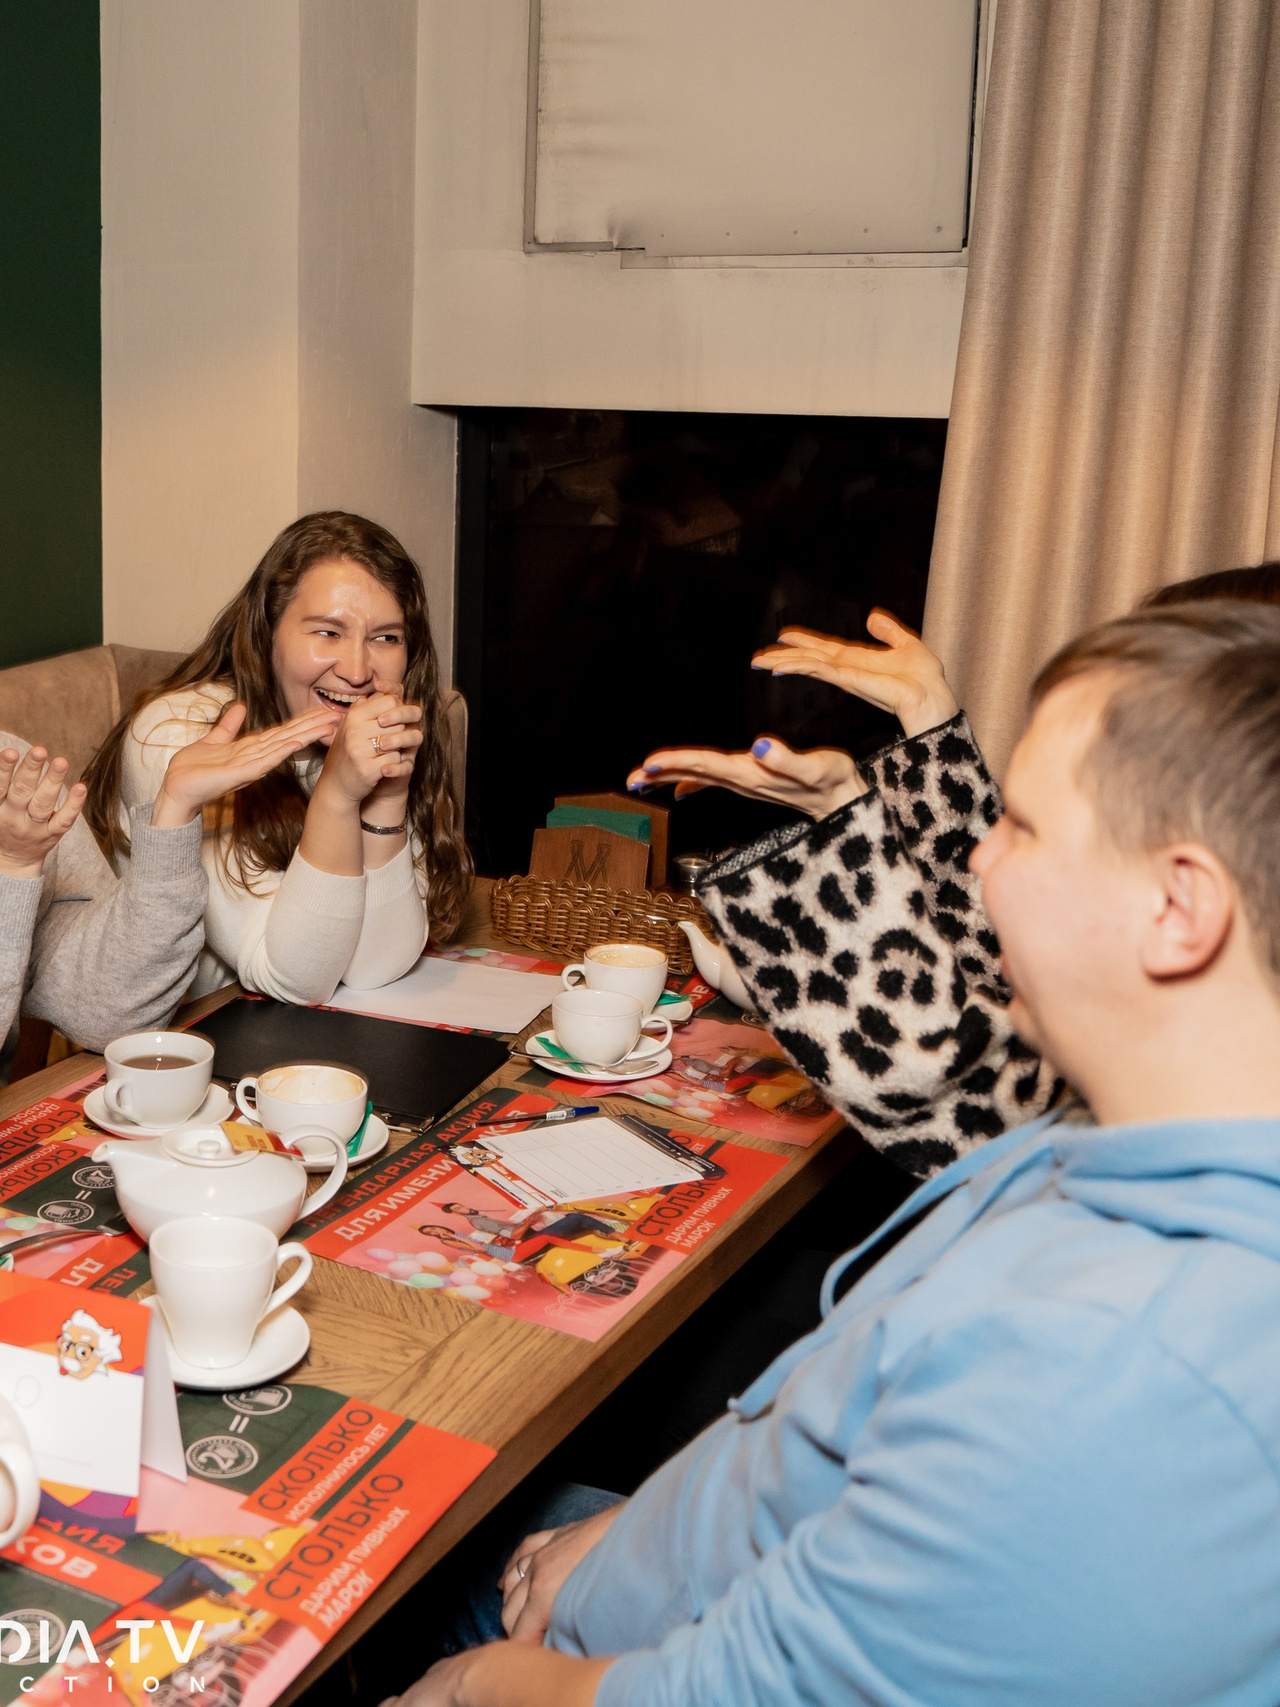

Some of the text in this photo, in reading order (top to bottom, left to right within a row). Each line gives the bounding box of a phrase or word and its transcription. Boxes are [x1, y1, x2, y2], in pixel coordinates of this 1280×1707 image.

[12, 1101, 50, 1122] МАРОК
[21, 1103, 61, 1126] ДАРИМ
[436, 1101, 498, 1143] АКЦИЯ
[333, 1206, 389, 1242] ДЛЯ
[665, 1186, 734, 1245] ДАРИМ ПИВНЫХ
[680, 1220, 717, 1249] МАРОК
[59, 1257, 105, 1287] ДЛ
[257, 1408, 375, 1512] СКОЛЬКО
[284, 1422, 389, 1523] ИСПОЛНИЛОСЬ ЛЕТ
[264, 1473, 405, 1601] СТОЛЬКО
[299, 1505, 411, 1617] ДАРИМ ПИВНЫХ
[318, 1568, 375, 1630] МАРОК
